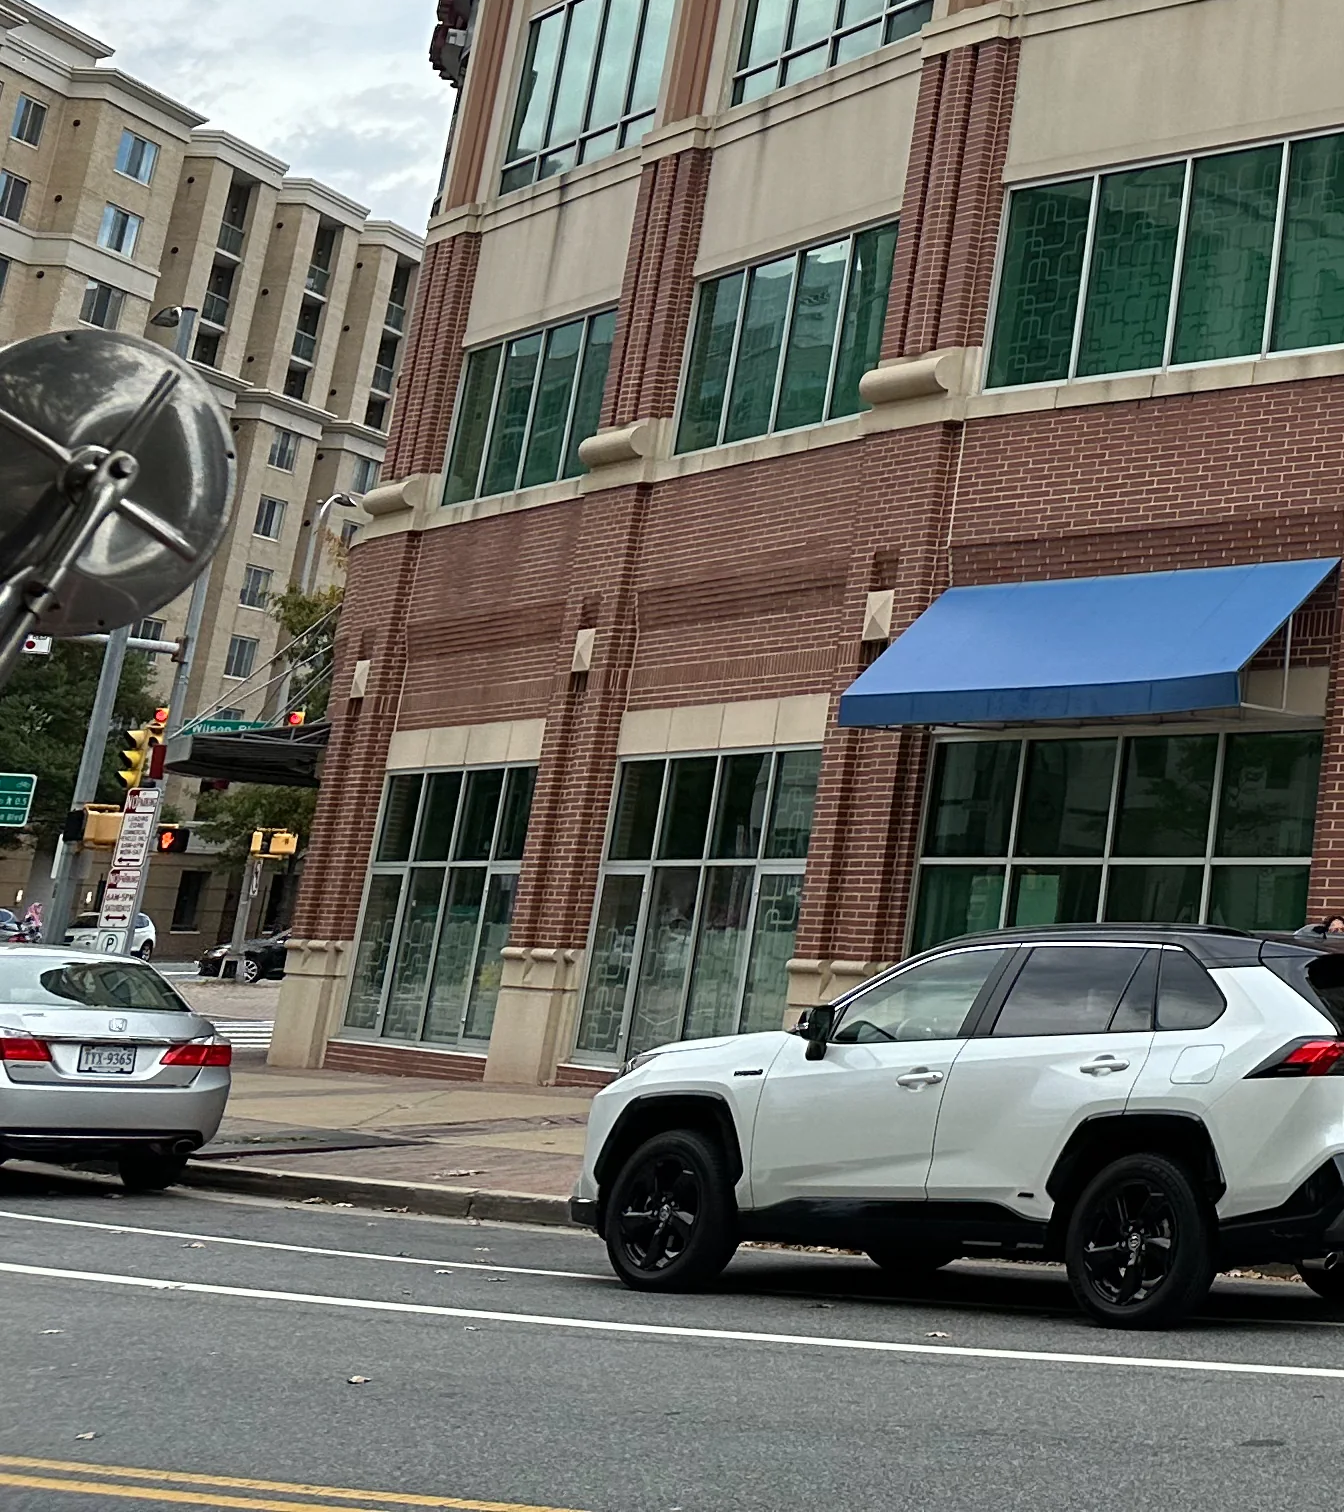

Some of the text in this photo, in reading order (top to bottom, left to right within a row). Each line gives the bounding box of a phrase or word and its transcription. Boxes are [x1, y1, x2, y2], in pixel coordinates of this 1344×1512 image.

[192, 724, 232, 733] Wilson
[126, 795, 138, 809] NO
[85, 1052, 132, 1065] TYX-9365
